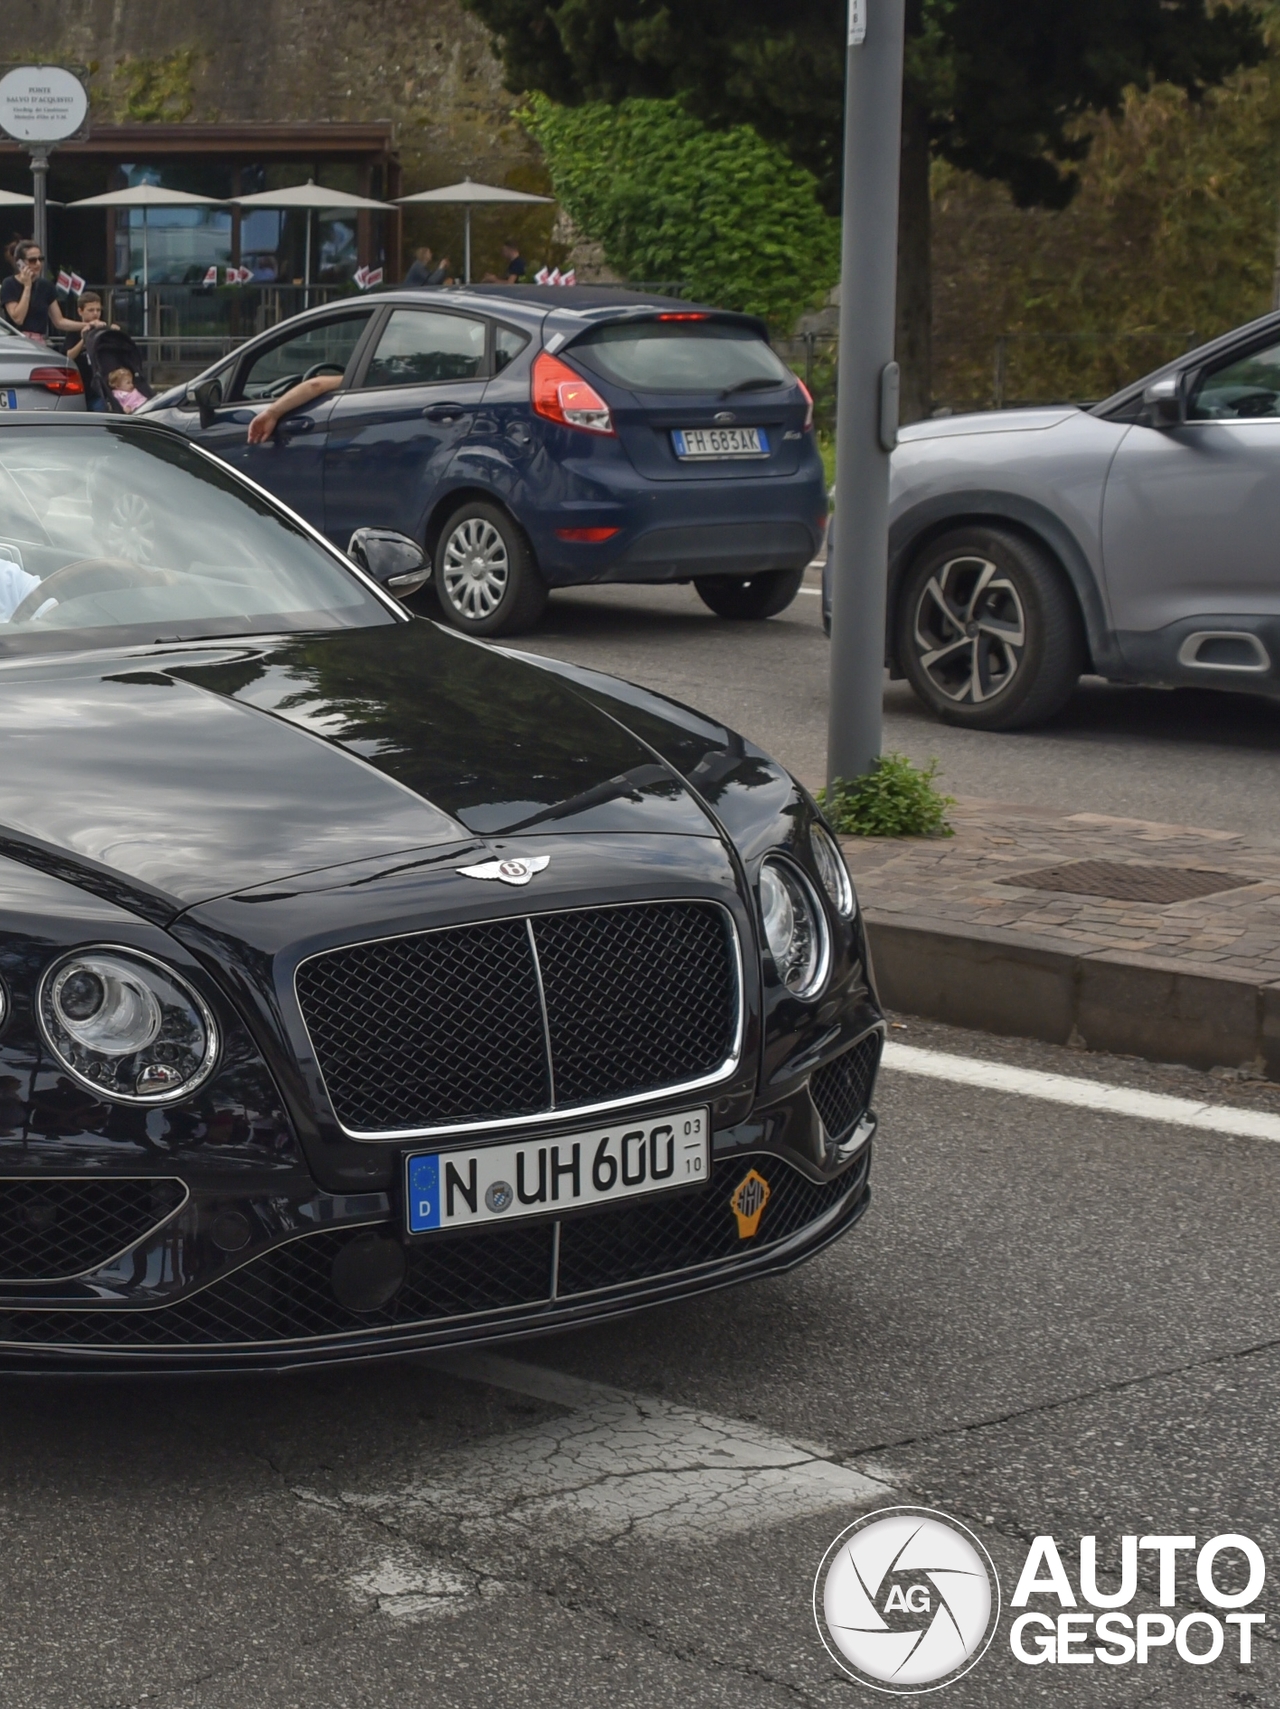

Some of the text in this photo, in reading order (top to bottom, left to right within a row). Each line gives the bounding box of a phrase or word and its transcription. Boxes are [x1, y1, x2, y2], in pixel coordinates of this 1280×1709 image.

[683, 1118, 701, 1136] 03
[685, 1156, 702, 1174] 10
[419, 1200, 431, 1217] D
[445, 1157, 477, 1218] N
